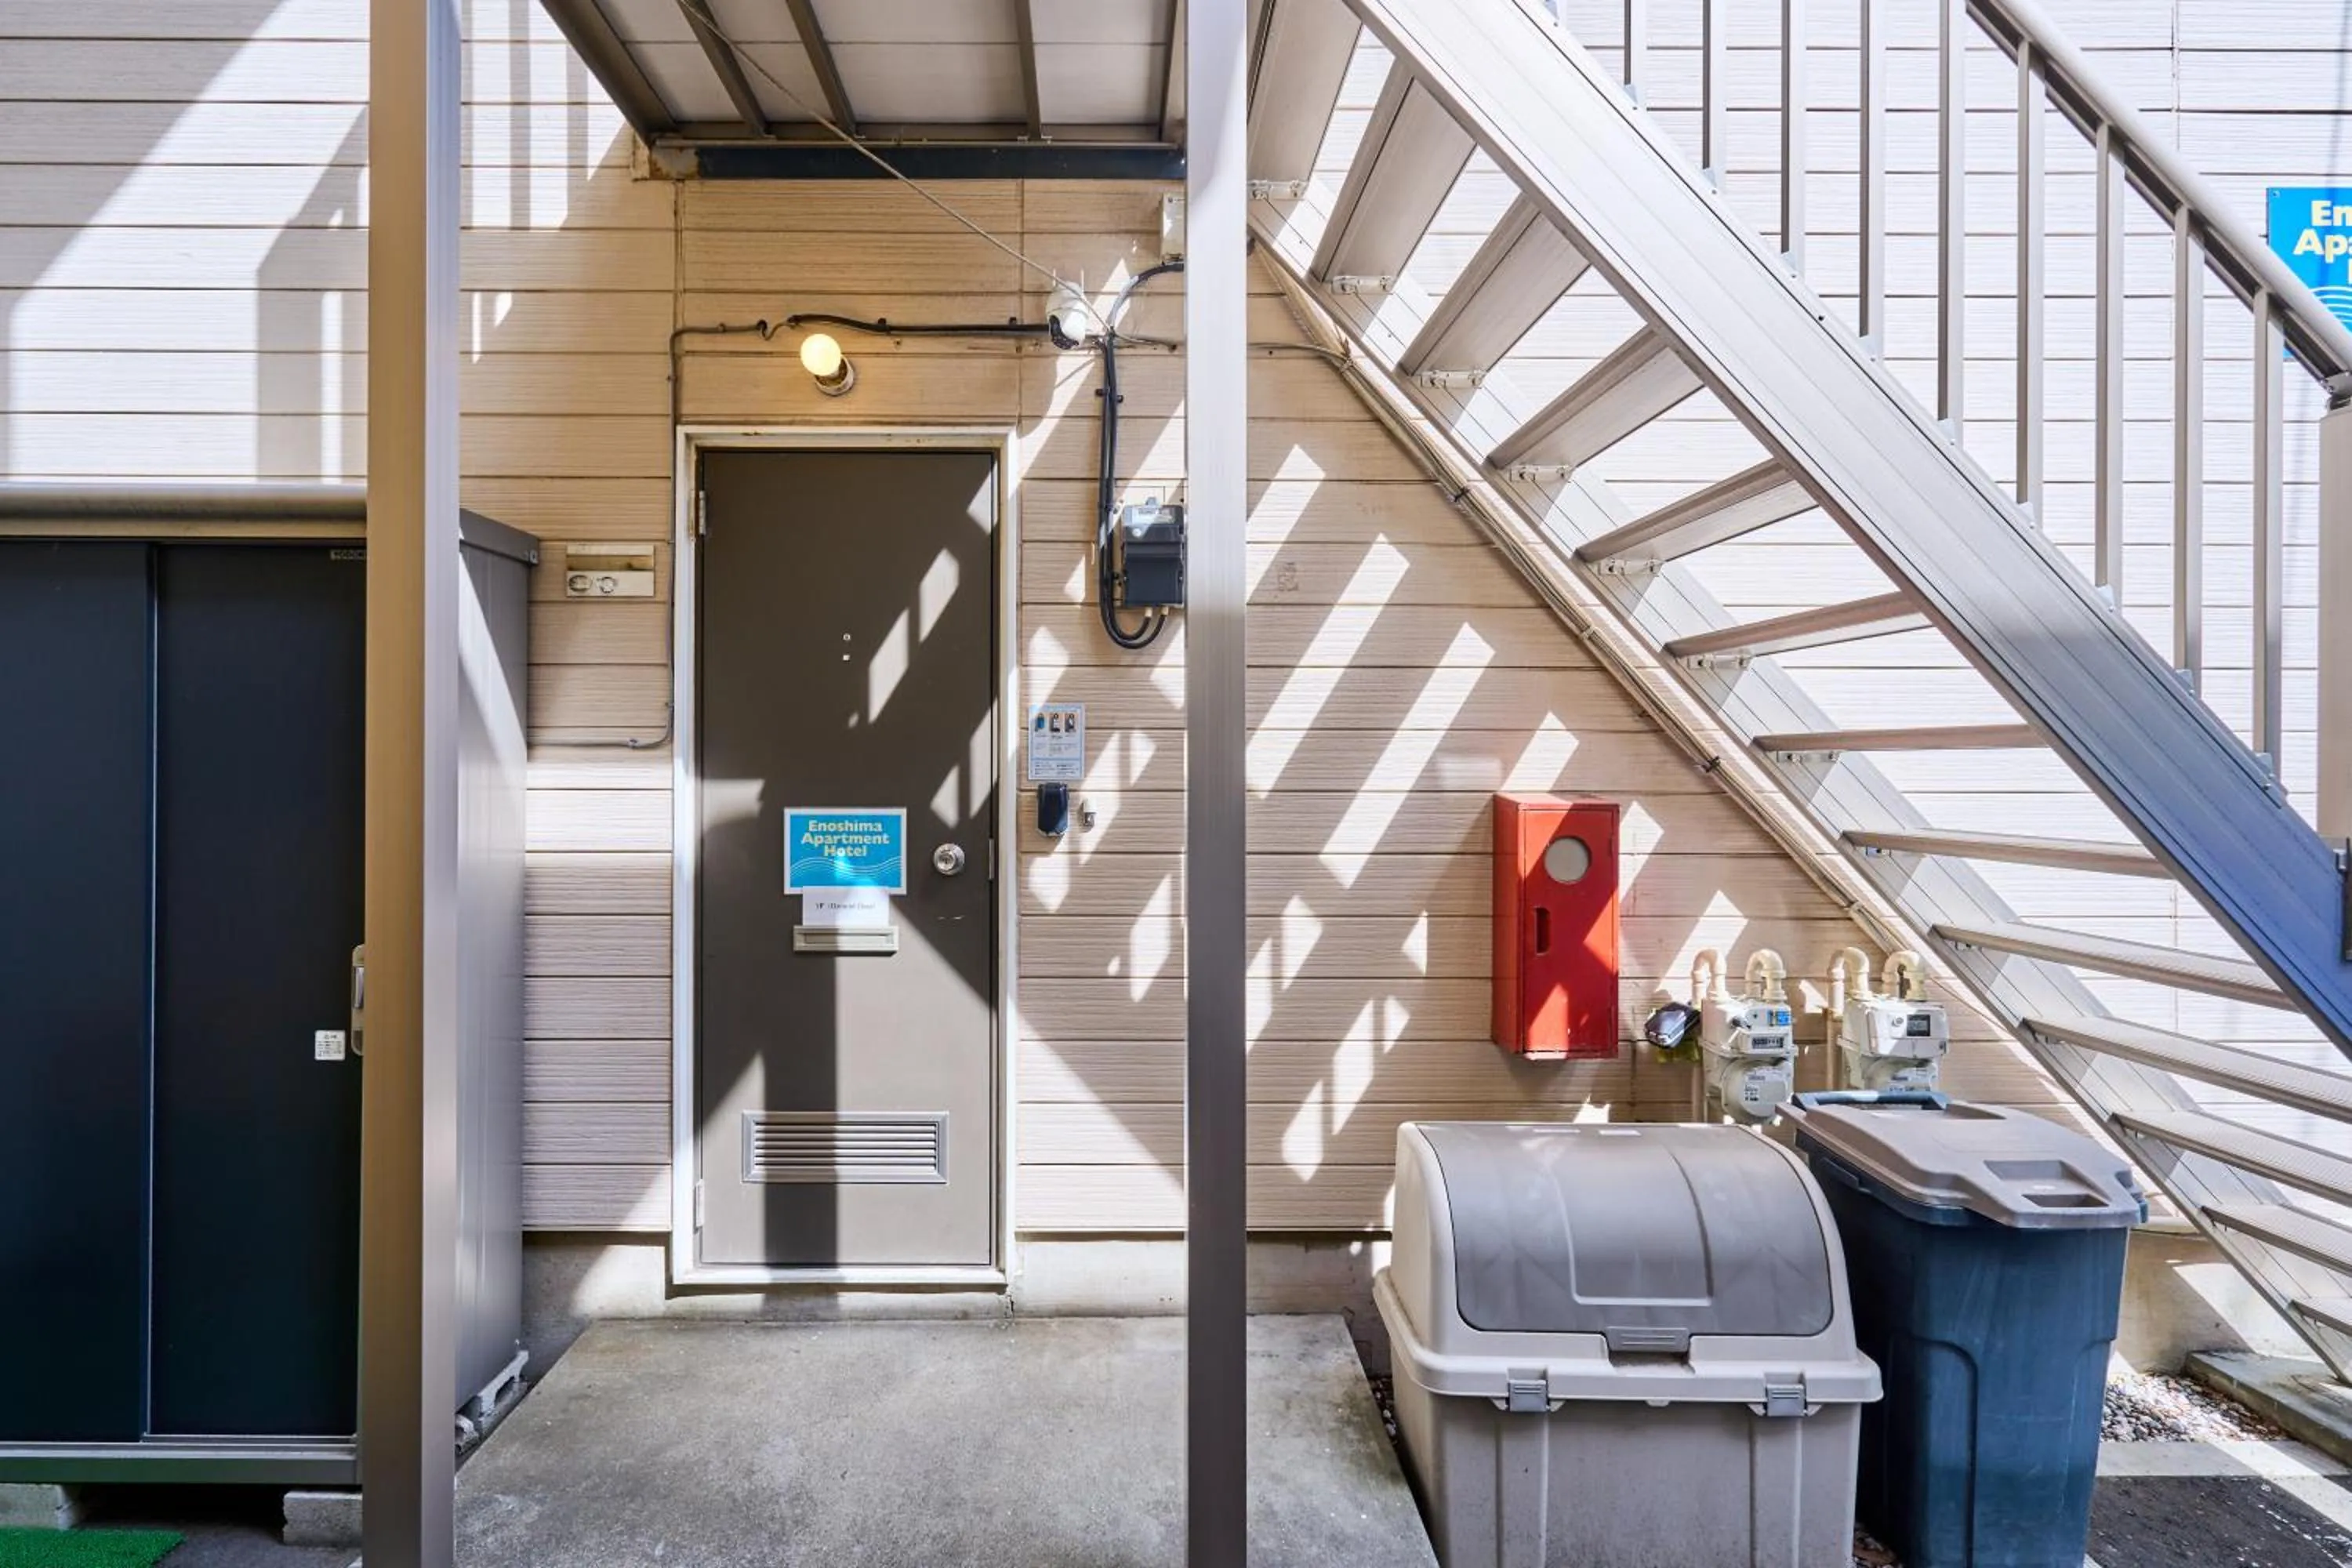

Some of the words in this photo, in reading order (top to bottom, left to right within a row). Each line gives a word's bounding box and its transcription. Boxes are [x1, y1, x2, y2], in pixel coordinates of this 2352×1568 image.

[2292, 228, 2352, 263] Ap
[808, 820, 882, 831] Enoshima
[801, 833, 890, 847] Apartment
[824, 846, 866, 856] Hotel
